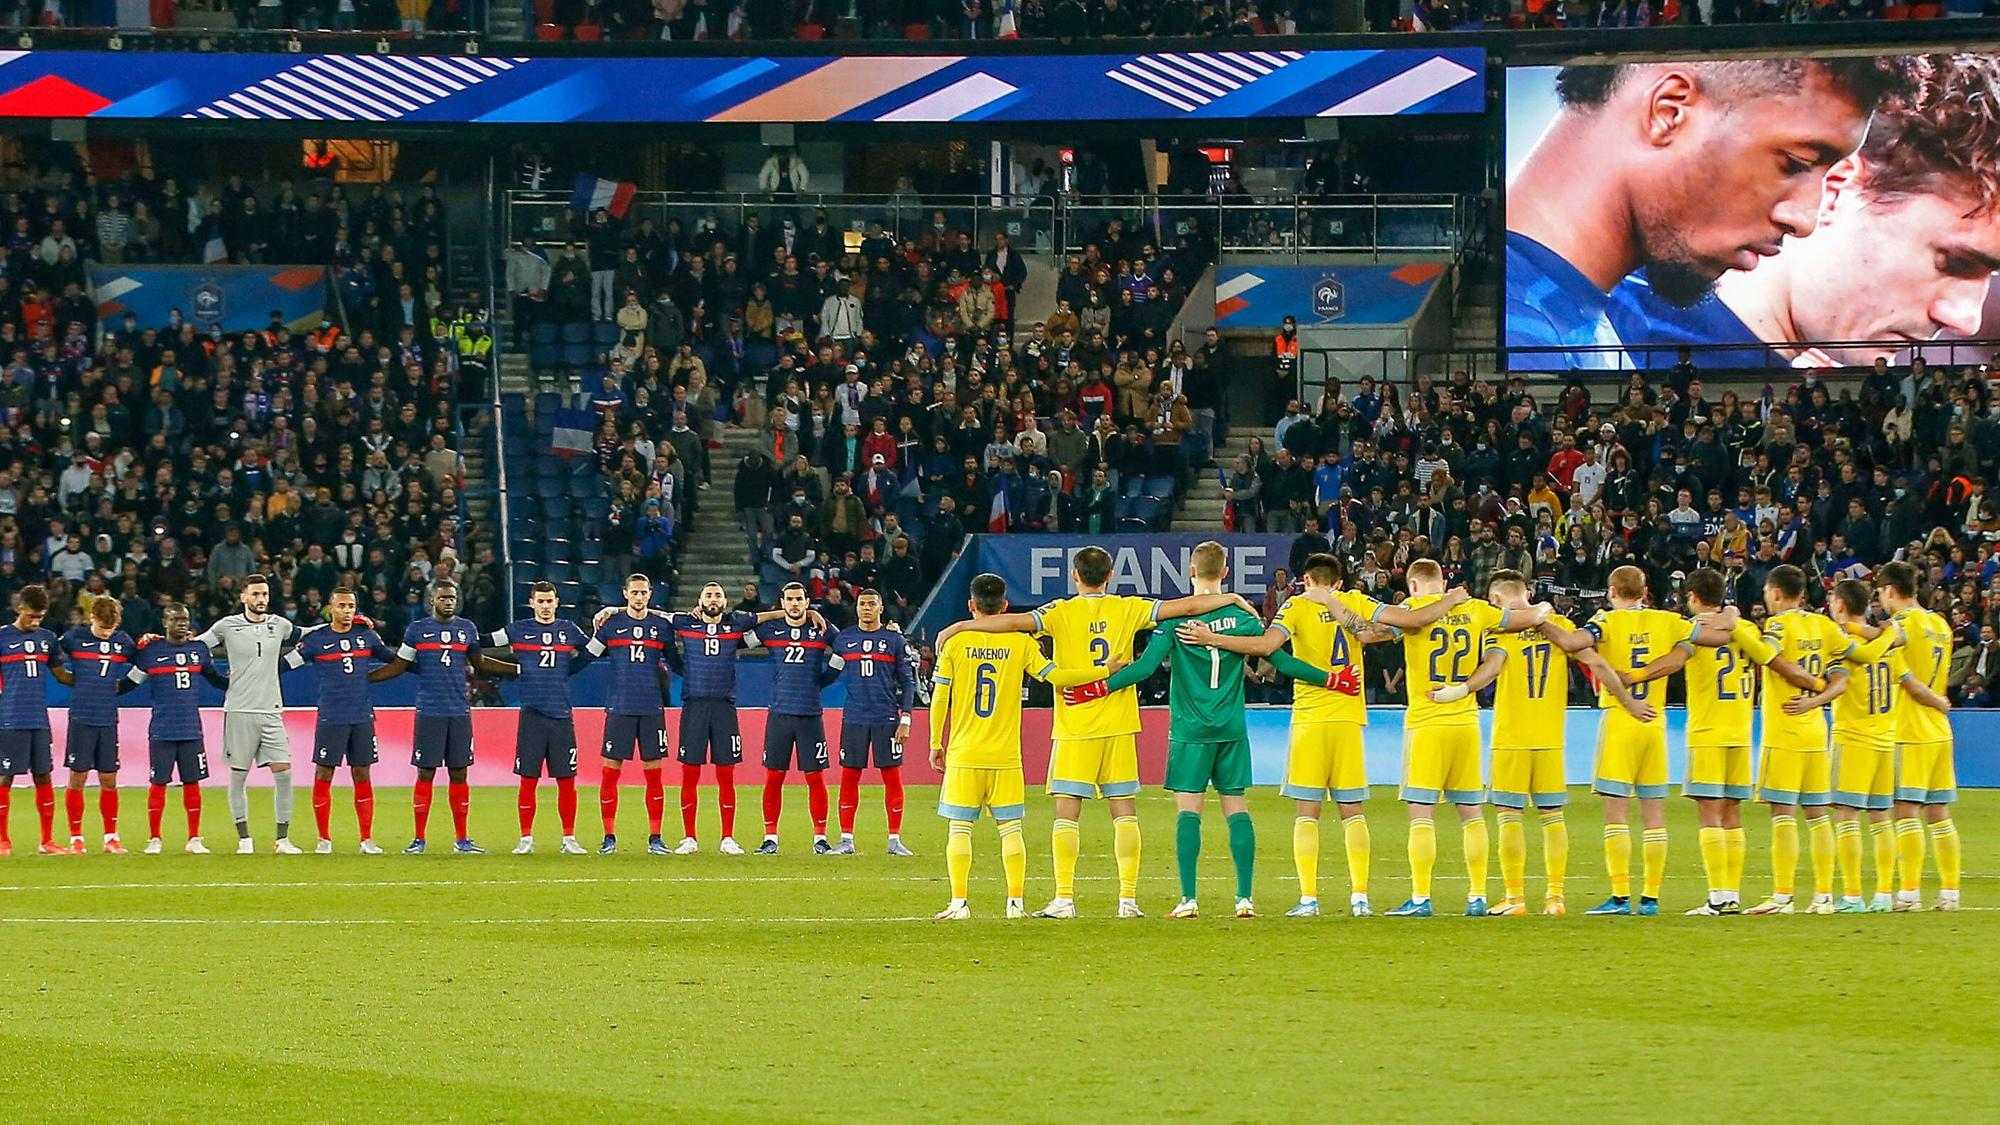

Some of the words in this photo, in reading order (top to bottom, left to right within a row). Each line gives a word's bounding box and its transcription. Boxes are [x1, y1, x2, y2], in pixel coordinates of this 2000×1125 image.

[1030, 547, 1268, 595] FANE
[1089, 620, 1108, 634] ALIP
[256, 641, 262, 657] 1
[629, 645, 645, 663] 14
[703, 638, 720, 656] 19
[965, 646, 1011, 661] TAIKENOV
[1330, 625, 1351, 667] 4
[1429, 626, 1472, 683] 22
[440, 649, 452, 667] 4
[539, 650, 556, 668] 21
[784, 647, 805, 664] 22
[25, 660, 38, 678] 11
[99, 660, 111, 677] 7
[342, 657, 354, 674] 3
[859, 659, 874, 677] 10
[1206, 642, 1221, 689] 1
[1521, 643, 1552, 699] 17
[1928, 646, 1943, 689] 7
[175, 671, 191, 689] 13
[1865, 661, 1891, 715] 10
[974, 662, 997, 718] 6
[730, 735, 742, 752] 19
